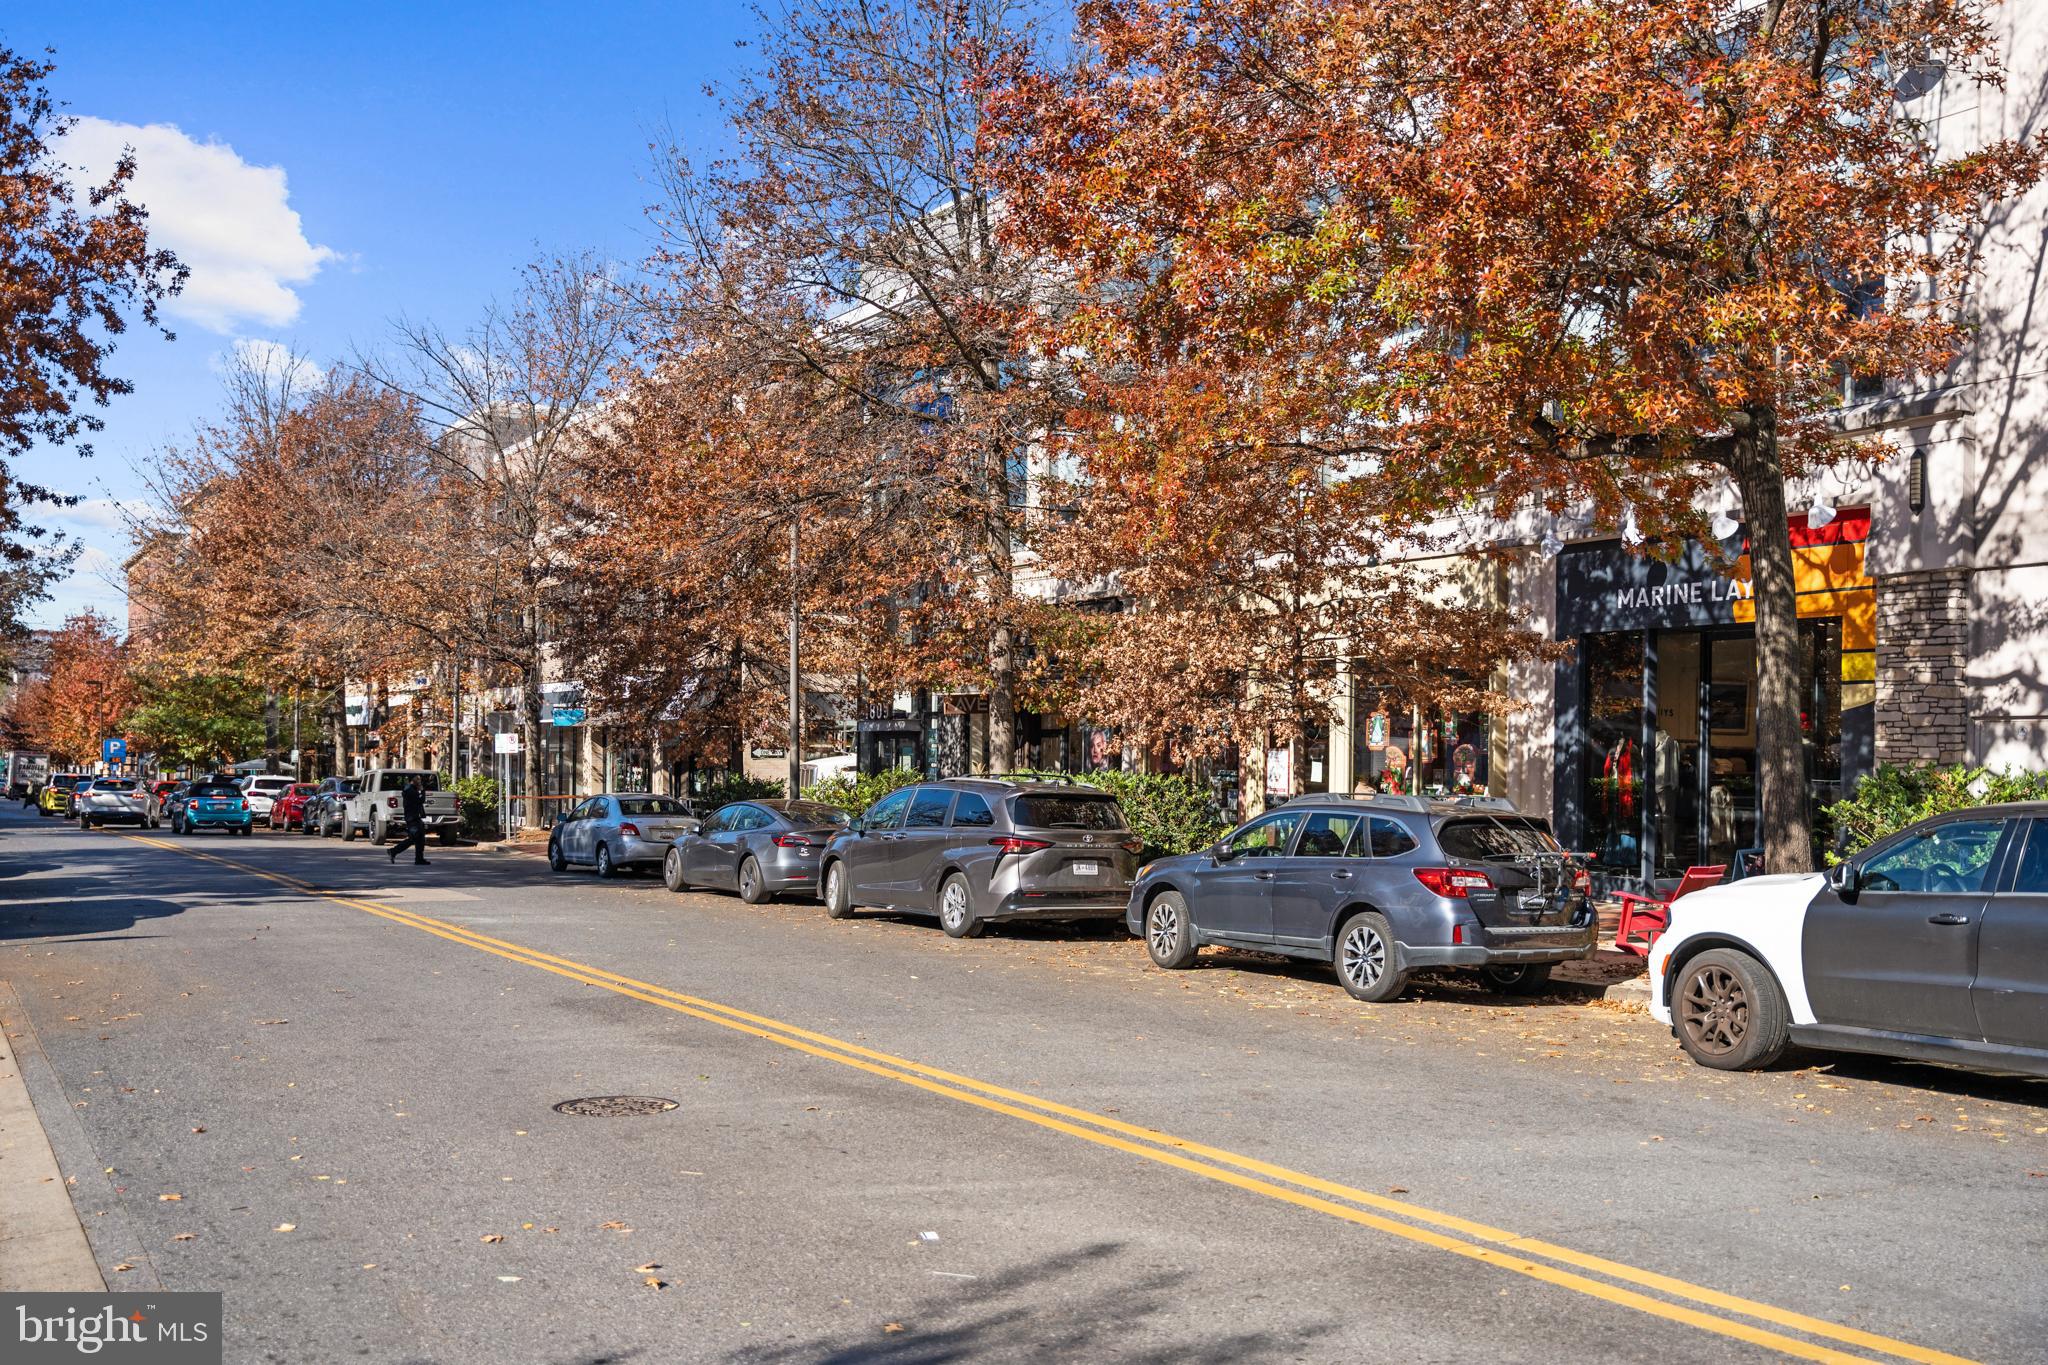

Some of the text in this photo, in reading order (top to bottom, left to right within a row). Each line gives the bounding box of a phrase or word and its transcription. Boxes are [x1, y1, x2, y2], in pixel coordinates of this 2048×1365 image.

[1617, 579, 1754, 609] MARINE LAY
[110, 741, 121, 754] P
